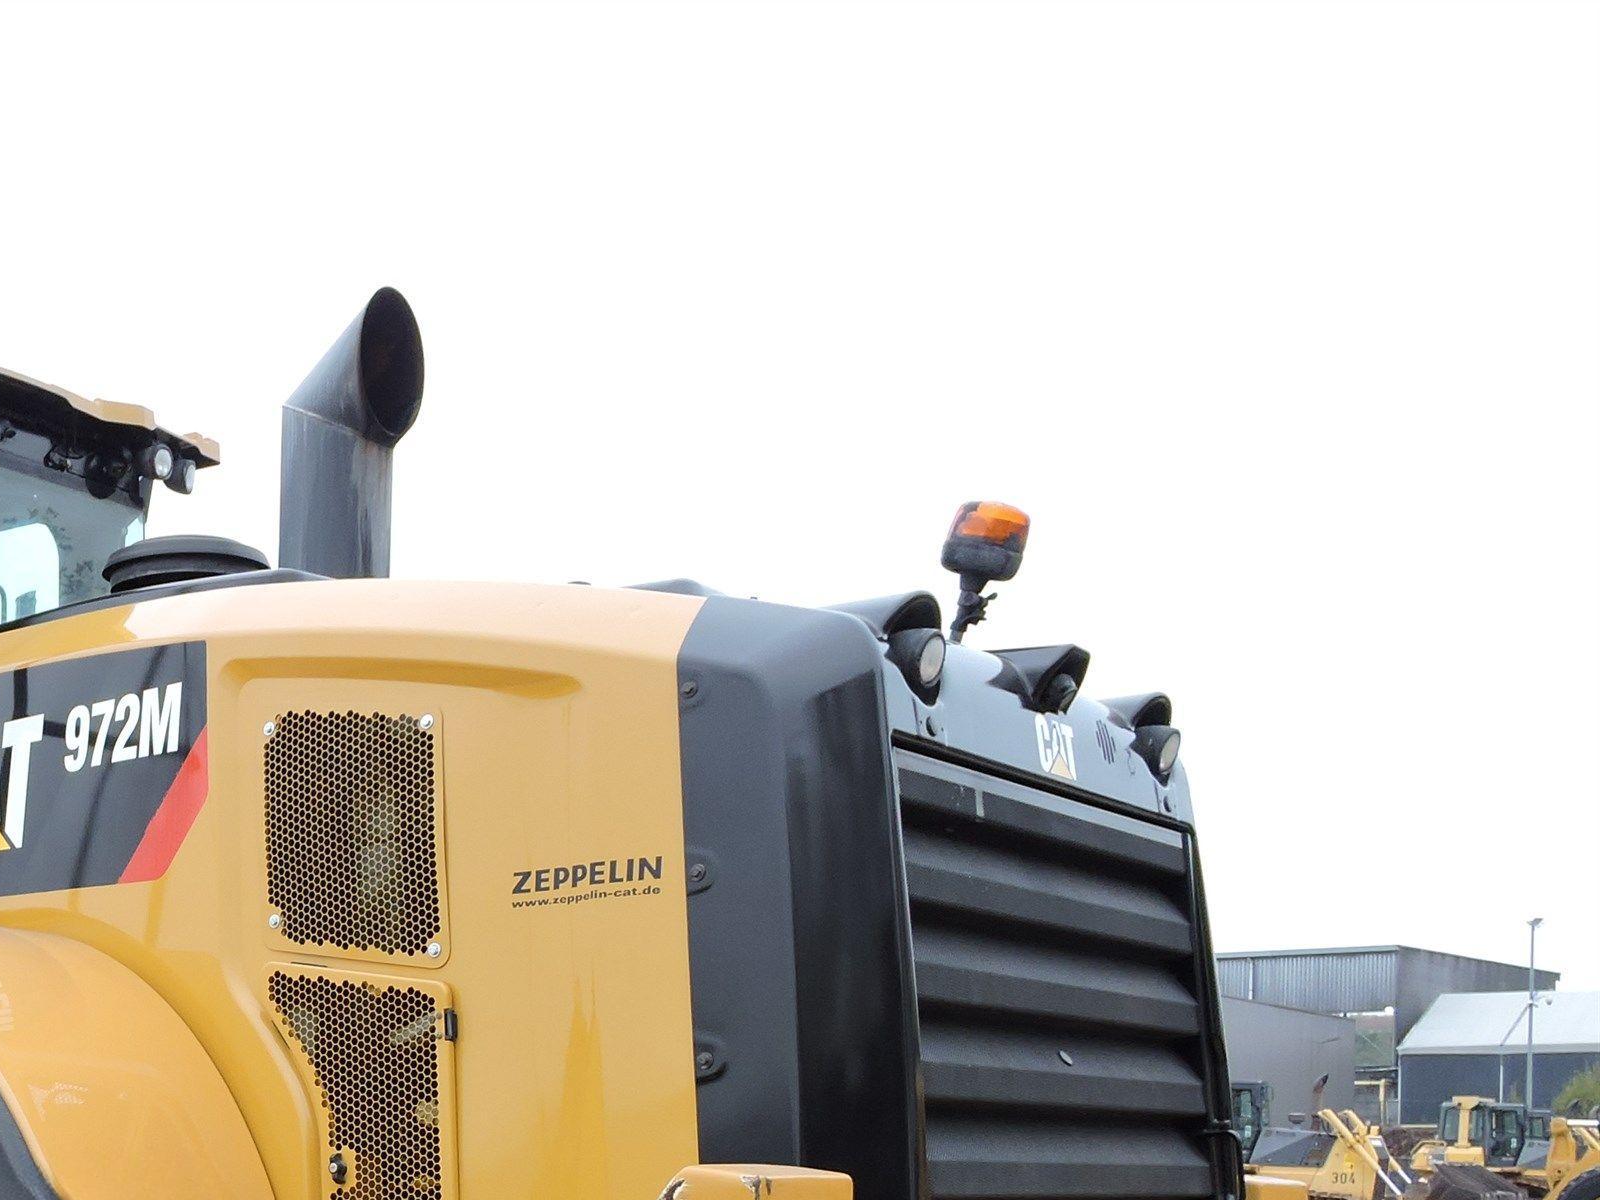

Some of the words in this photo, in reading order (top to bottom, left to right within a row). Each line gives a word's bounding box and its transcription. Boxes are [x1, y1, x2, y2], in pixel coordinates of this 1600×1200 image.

[63, 681, 183, 774] 972M
[1034, 713, 1077, 782] CAT
[512, 856, 663, 895] ZEPPELIN
[512, 885, 662, 908] www.zeppelin-cat.de
[1331, 1172, 1355, 1185] 304
